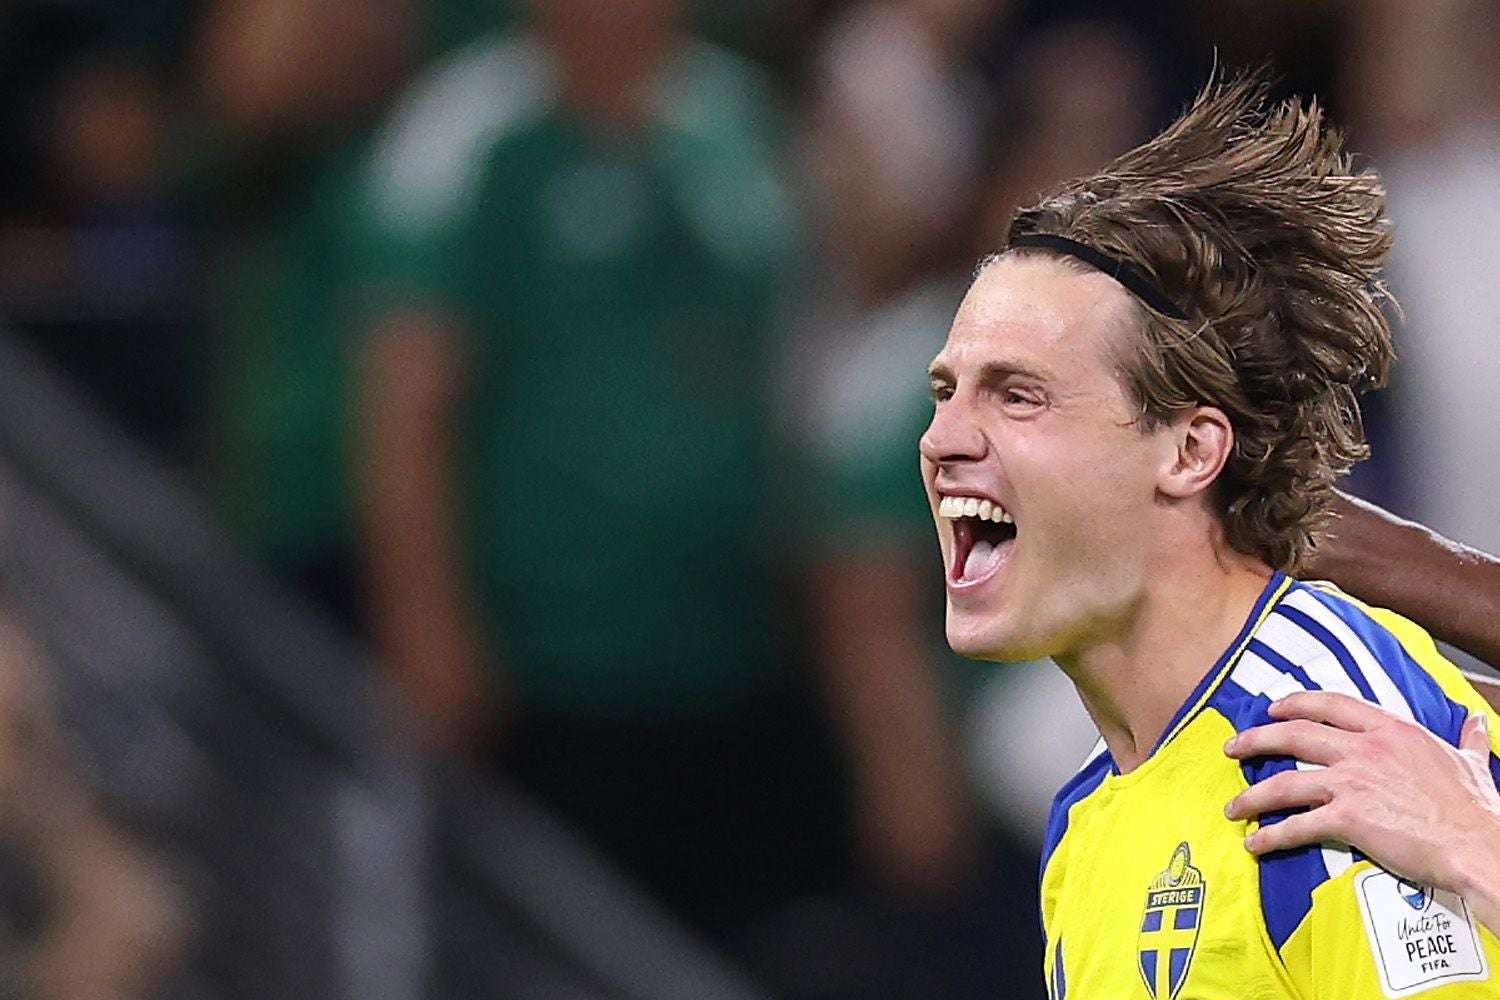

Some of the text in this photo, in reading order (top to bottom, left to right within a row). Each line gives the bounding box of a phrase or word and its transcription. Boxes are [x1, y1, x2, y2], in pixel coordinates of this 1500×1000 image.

[1151, 890, 1194, 906] SVERIGE
[1398, 913, 1450, 940] Unite For
[1406, 935, 1457, 962] PEACE
[1421, 959, 1450, 973] FIFA
